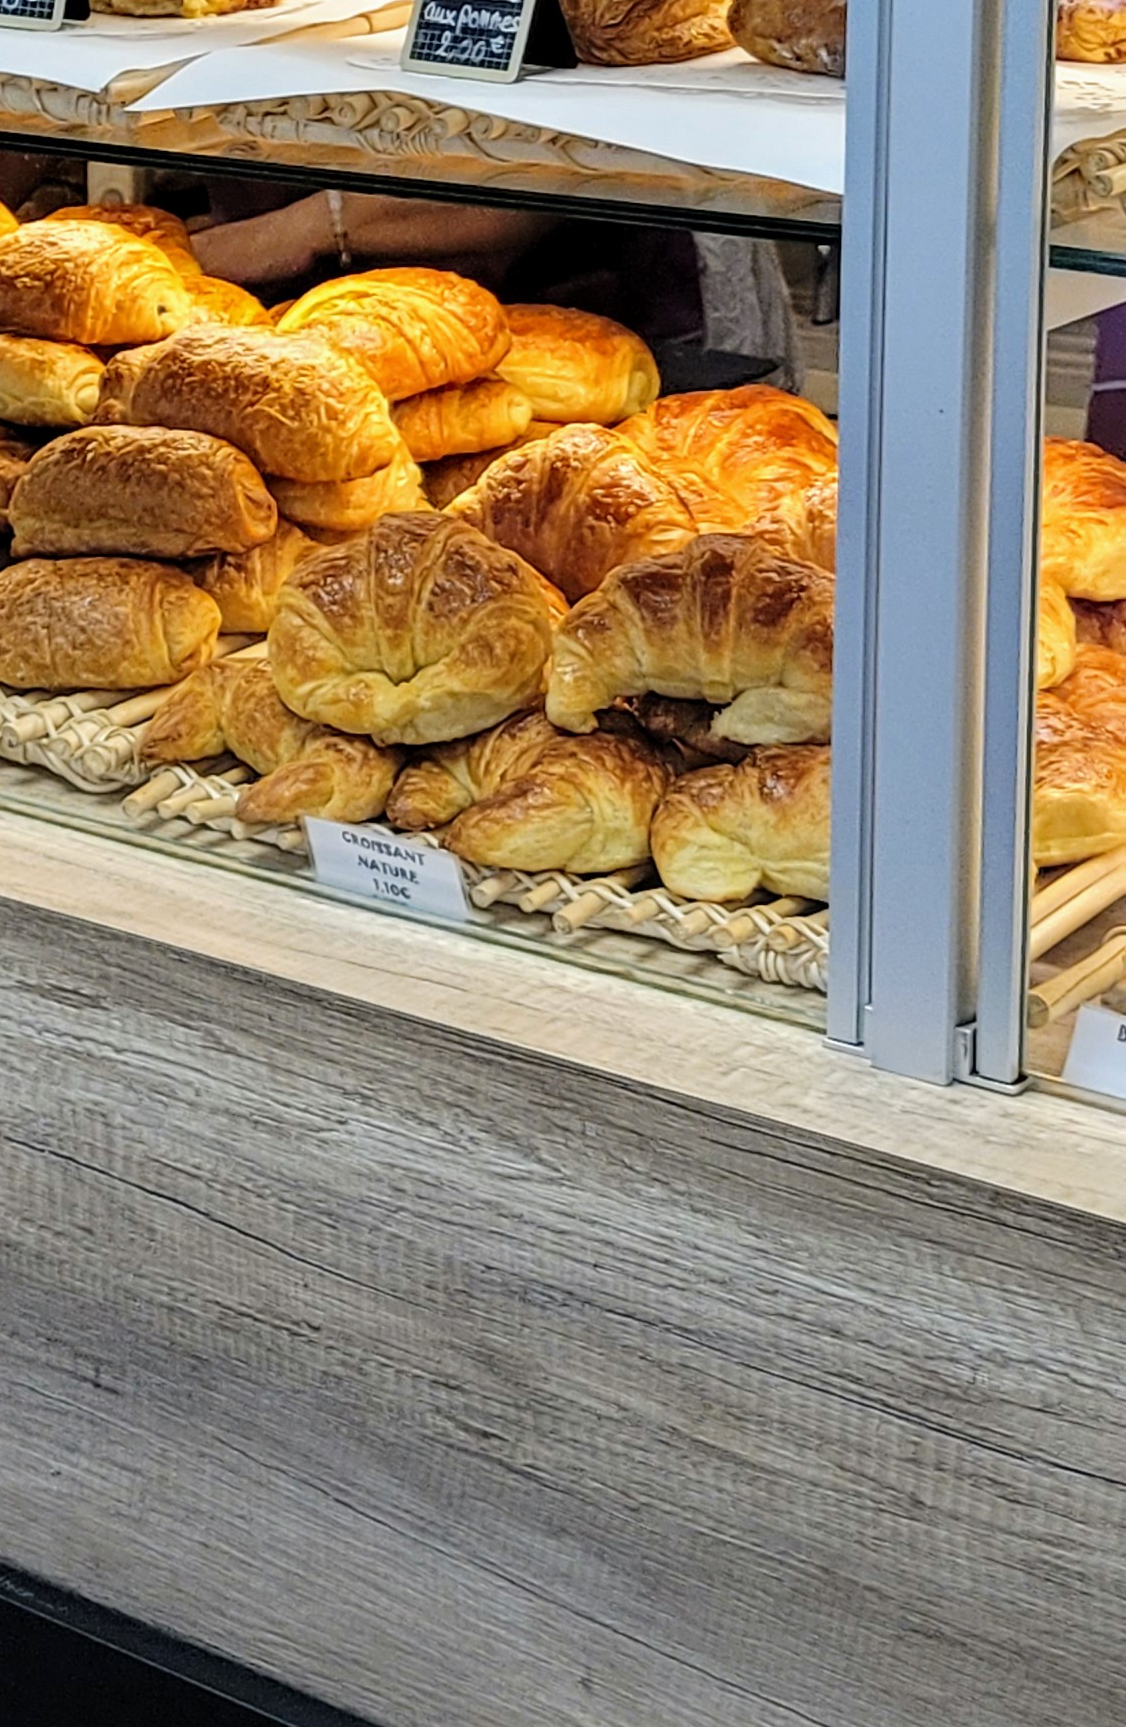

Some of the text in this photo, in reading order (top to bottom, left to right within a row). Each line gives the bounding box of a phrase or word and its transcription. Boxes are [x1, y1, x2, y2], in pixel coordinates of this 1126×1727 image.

[424, 1, 456, 26] aux
[341, 830, 426, 866] CROISSANT
[358, 854, 420, 884] NATURE
